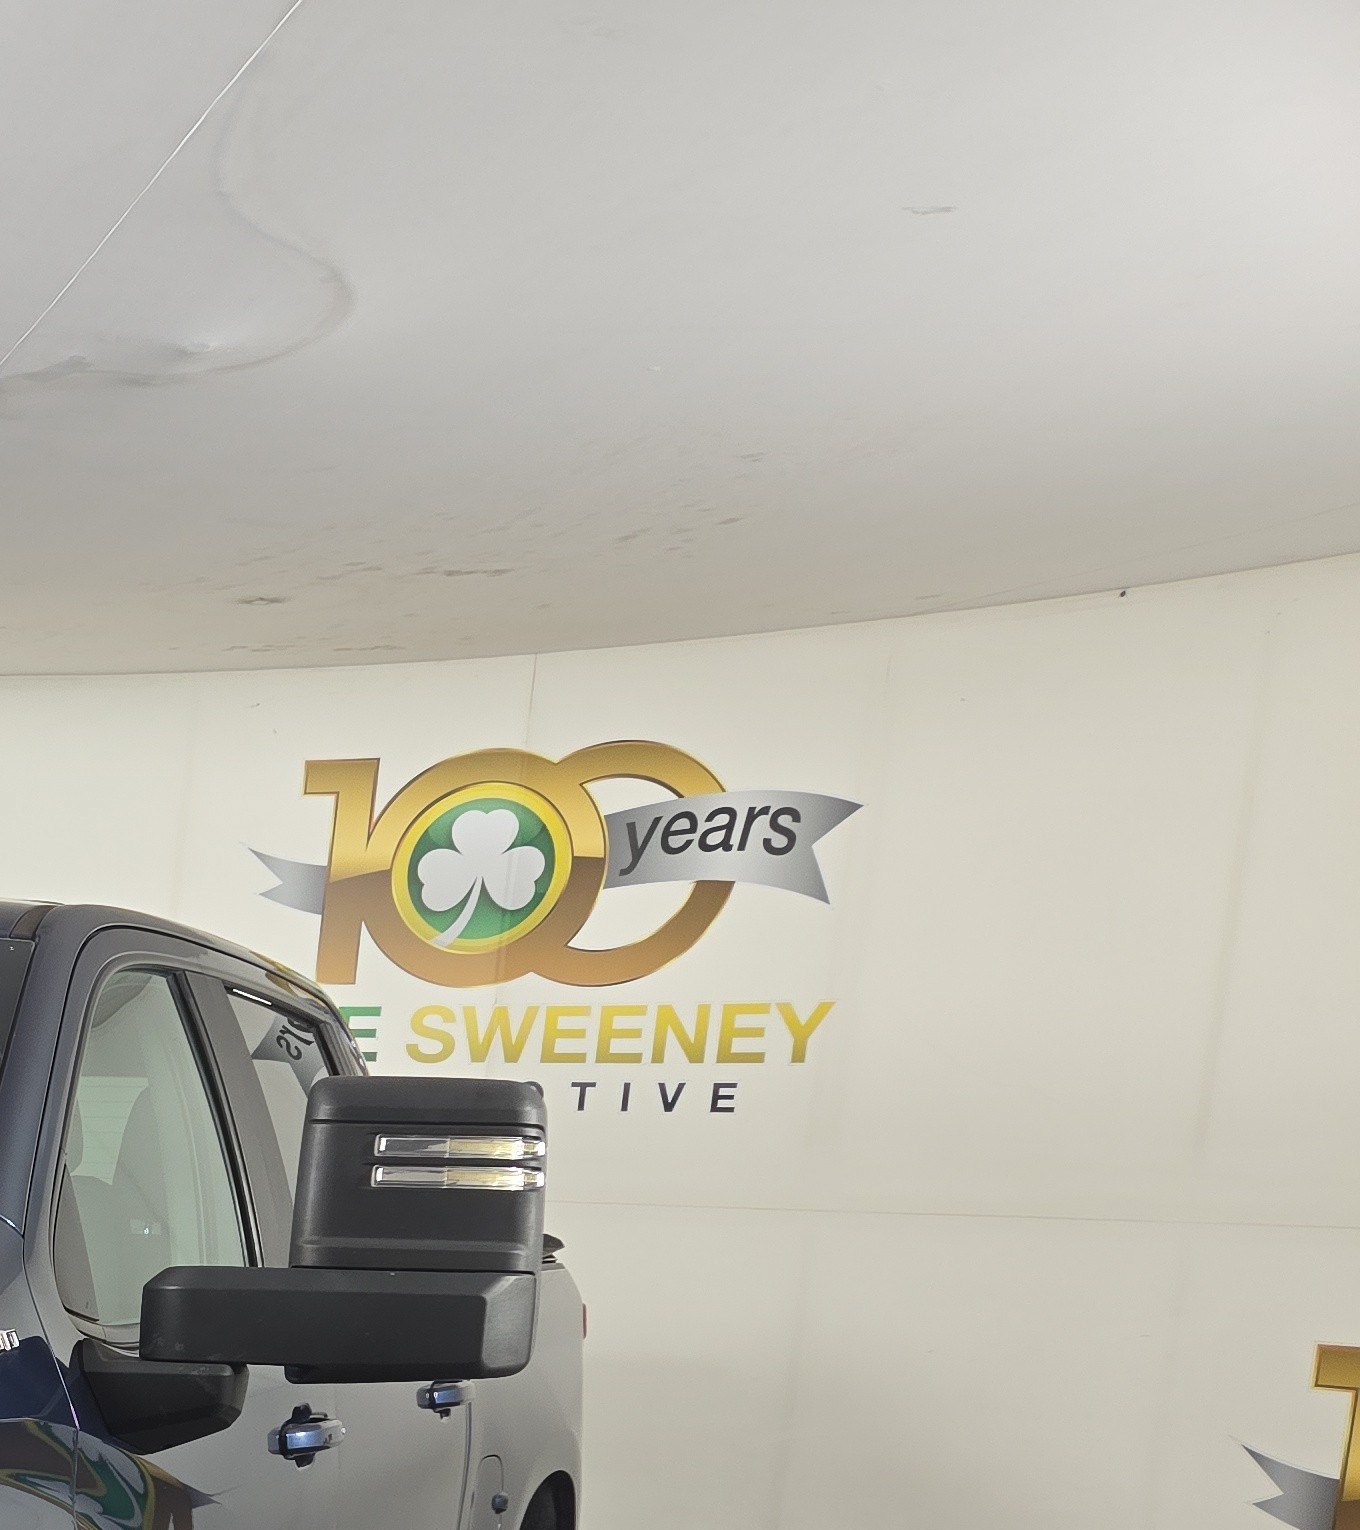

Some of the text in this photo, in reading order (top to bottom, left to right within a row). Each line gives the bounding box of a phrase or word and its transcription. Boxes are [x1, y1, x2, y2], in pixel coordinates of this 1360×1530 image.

[302, 739, 736, 987] 100
[618, 804, 801, 876] years
[405, 1001, 837, 1064] SWEENEY
